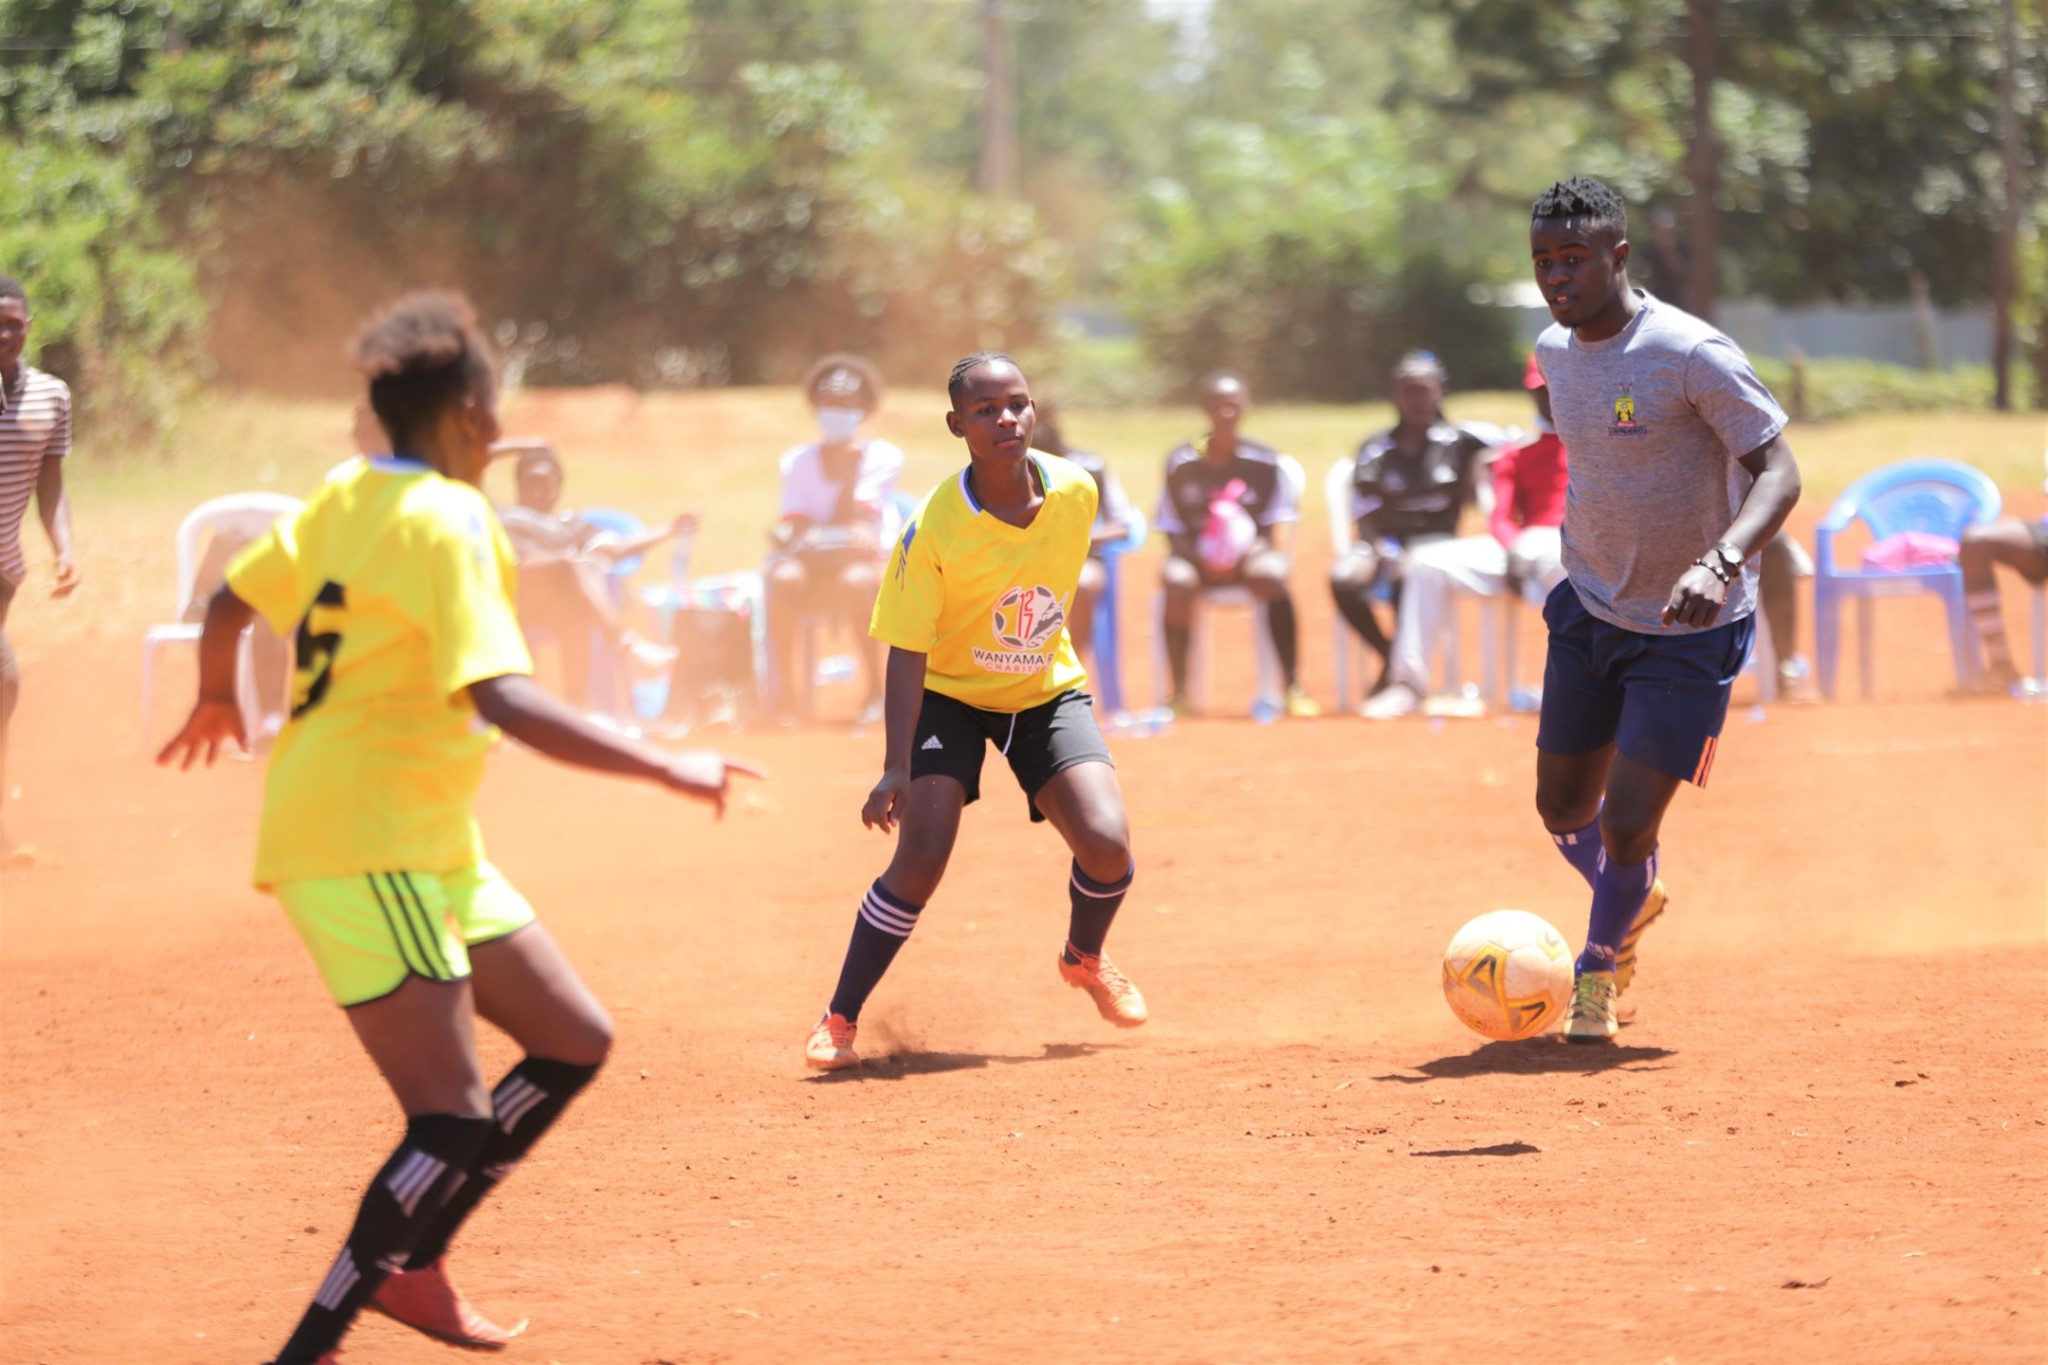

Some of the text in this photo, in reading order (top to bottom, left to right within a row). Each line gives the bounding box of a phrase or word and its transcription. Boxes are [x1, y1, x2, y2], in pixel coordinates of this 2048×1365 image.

[292, 580, 346, 721] 5
[973, 648, 1044, 666] WANYAMA
[985, 662, 1042, 673] CHARITY
